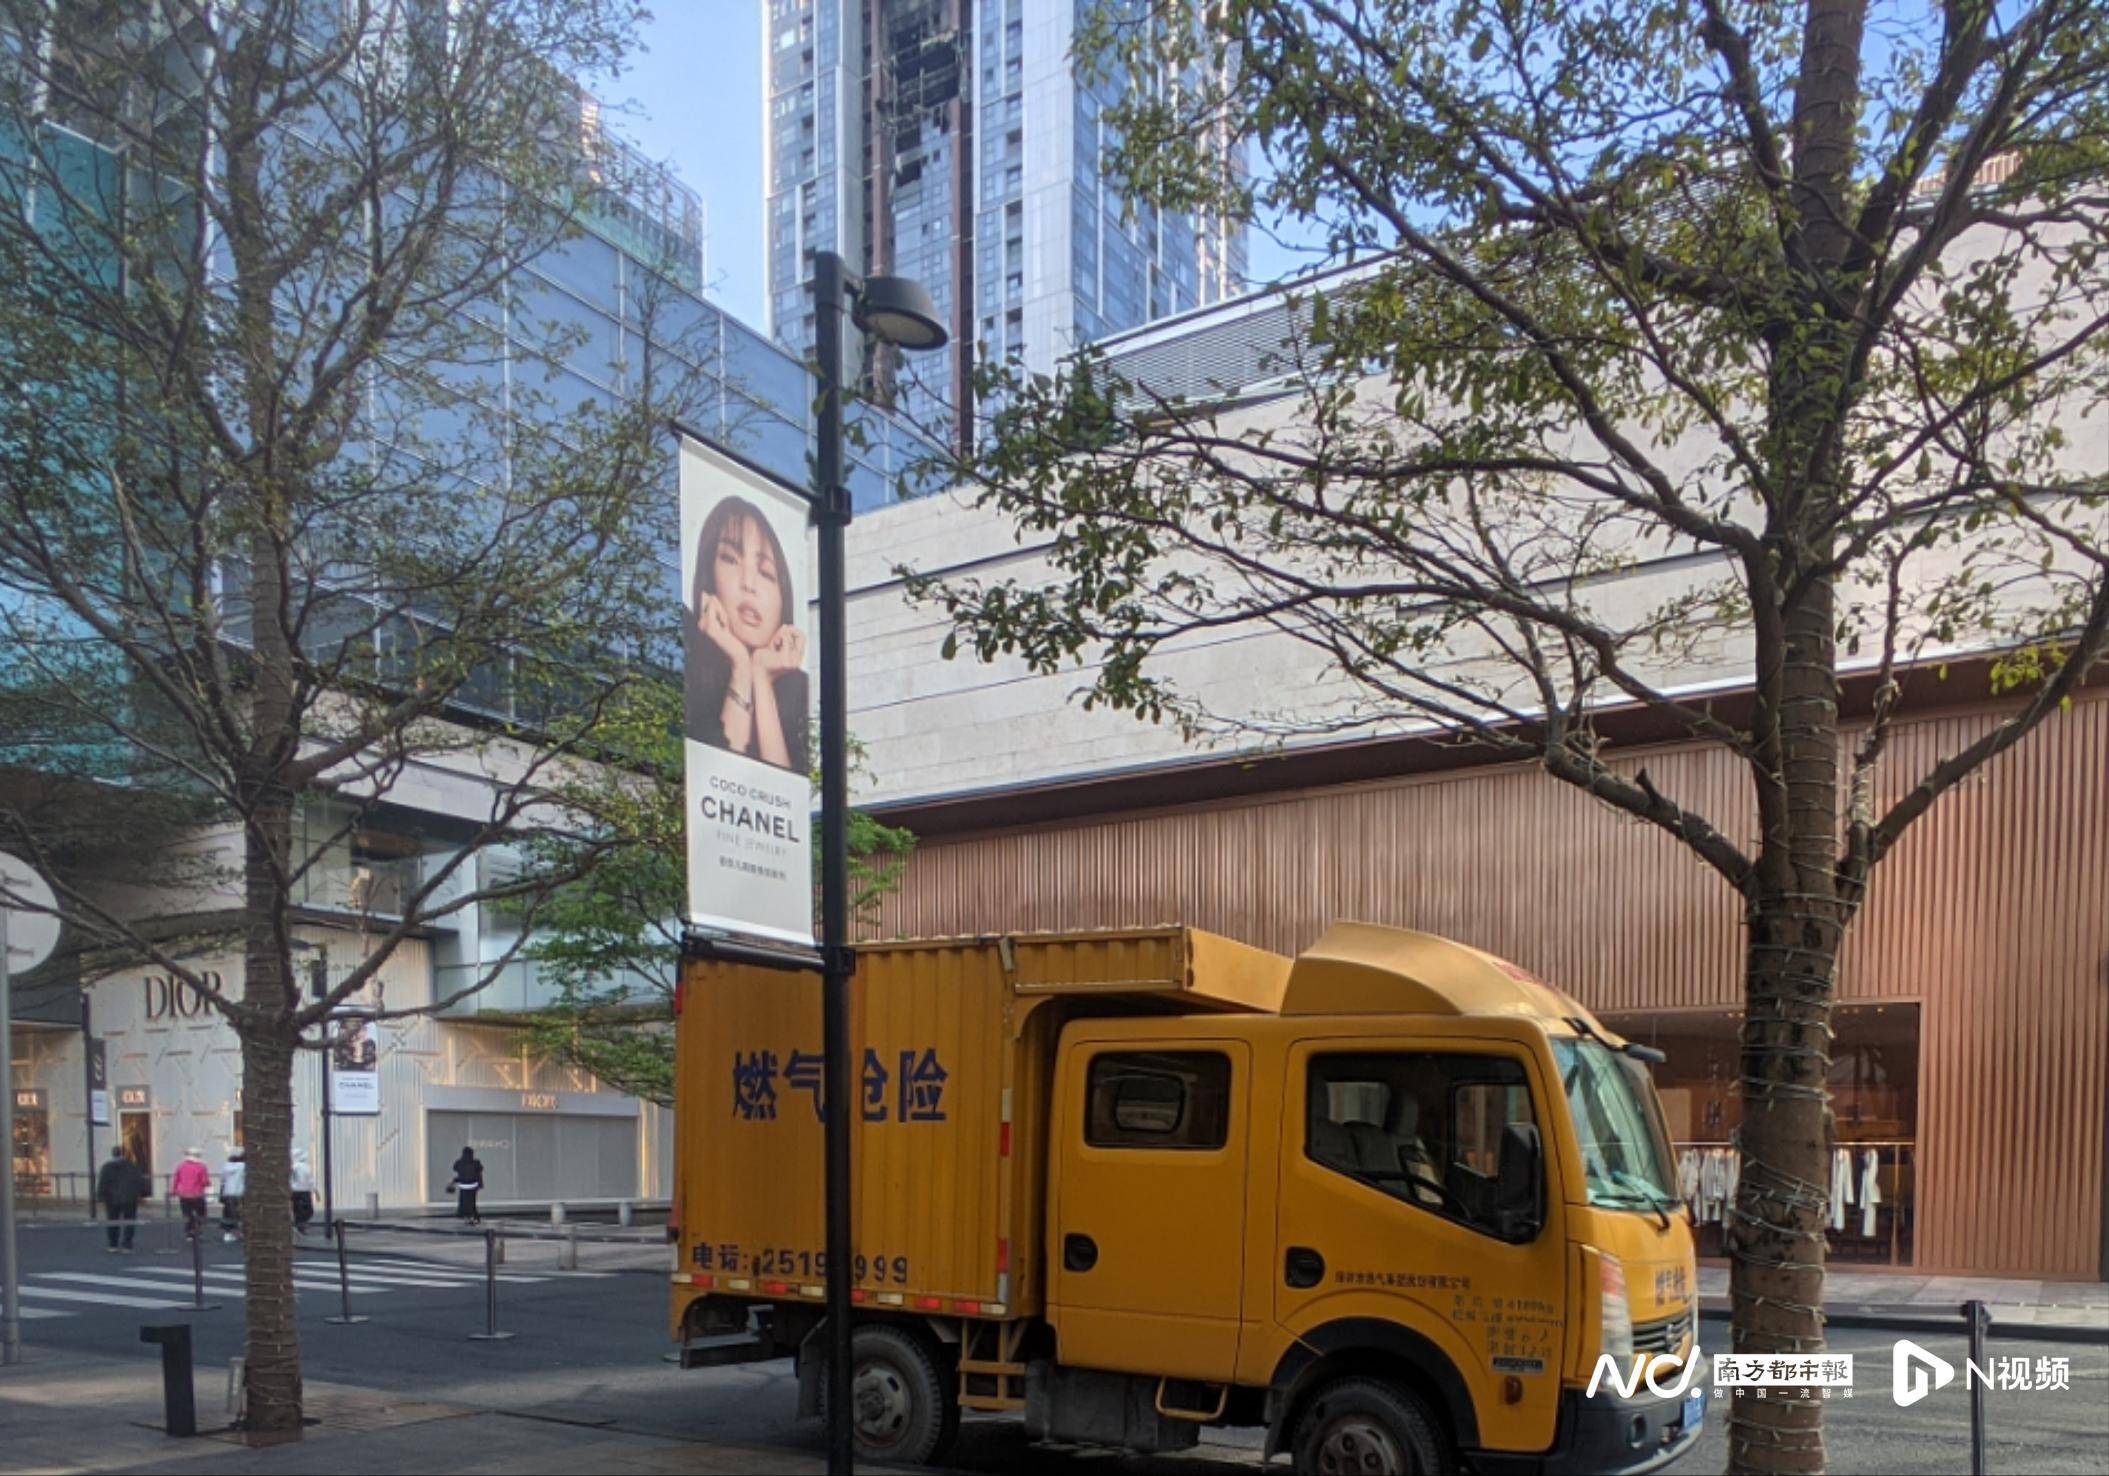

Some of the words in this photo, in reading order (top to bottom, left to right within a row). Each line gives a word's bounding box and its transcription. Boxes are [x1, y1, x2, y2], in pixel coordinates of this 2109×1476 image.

[709, 775, 747, 797] COCO
[749, 788, 791, 808] CRUSH
[701, 795, 800, 843] CHANEL
[144, 970, 221, 1022] DIOR
